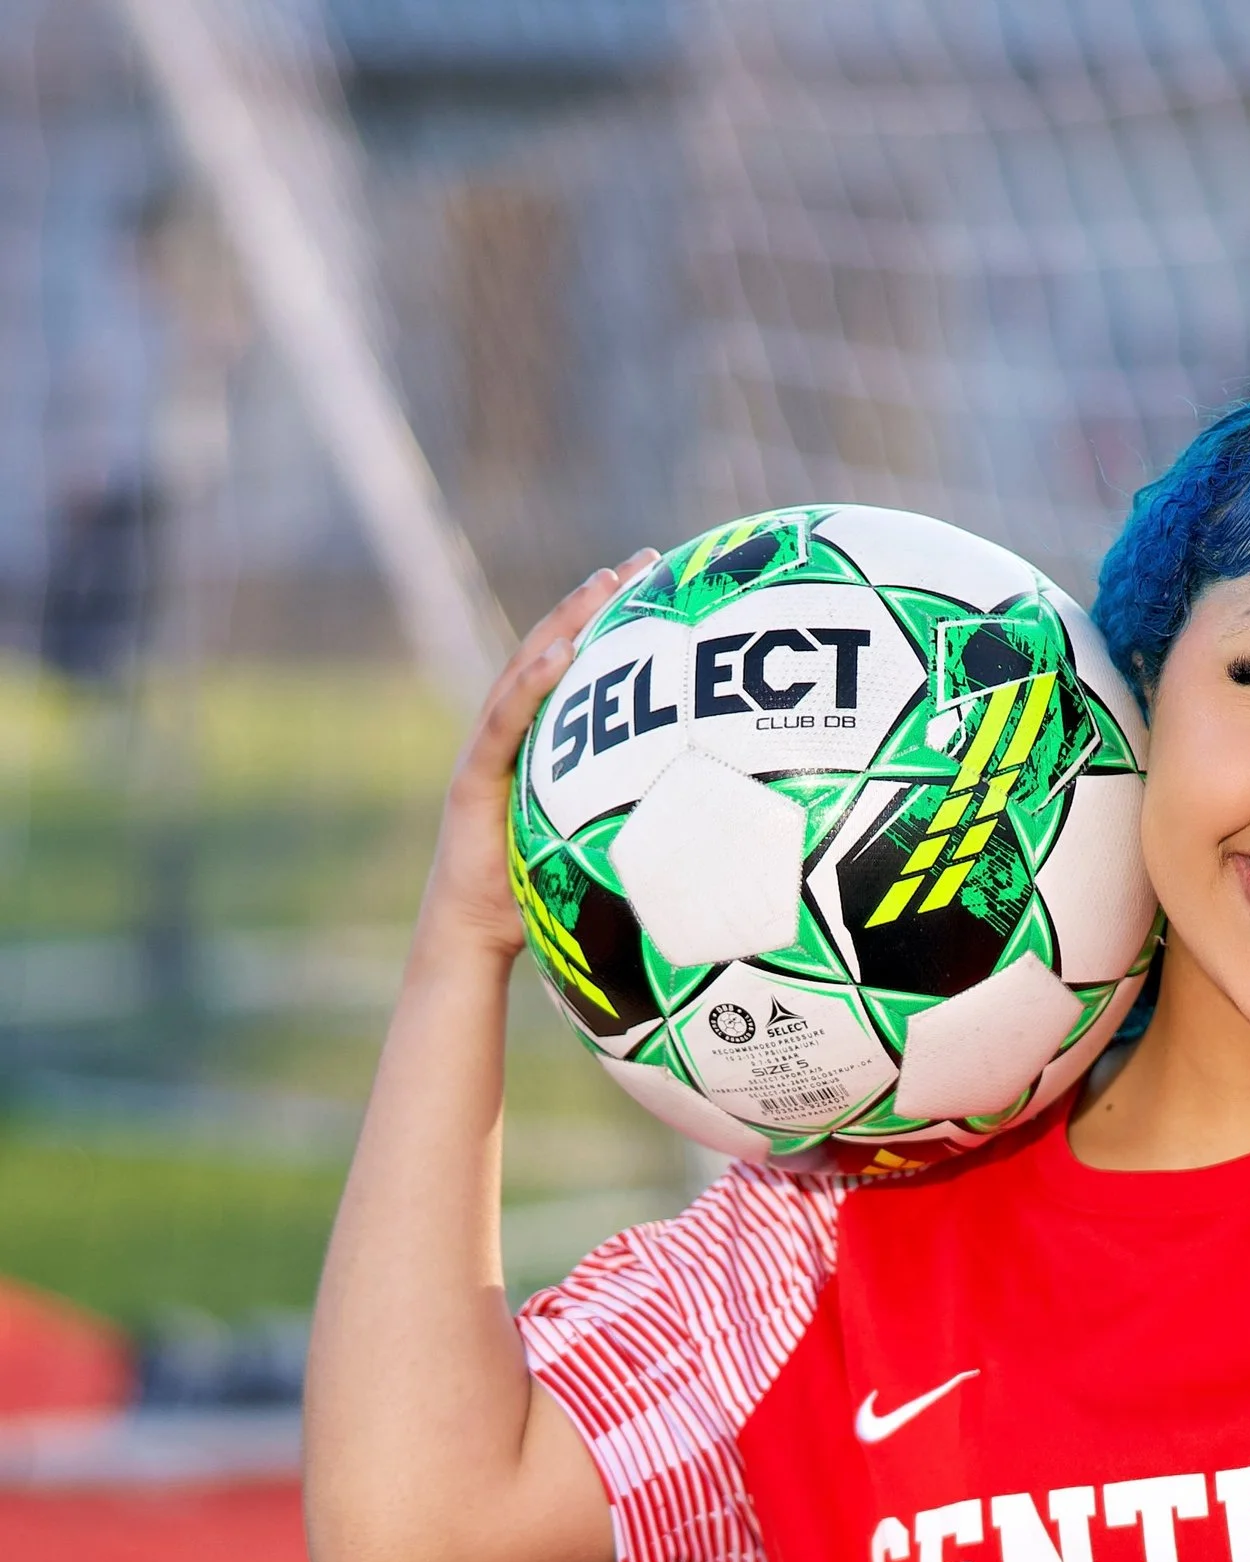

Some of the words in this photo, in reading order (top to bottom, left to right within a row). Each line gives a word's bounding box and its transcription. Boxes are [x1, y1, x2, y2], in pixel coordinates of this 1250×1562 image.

[552, 628, 871, 783] SELECT
[755, 715, 815, 730] CLUB
[823, 715, 856, 728] DB
[767, 1020, 809, 1038] SELECT
[712, 1041, 776, 1055] RECOMMENDED
[778, 1028, 826, 1045] PRESSURE
[781, 1052, 799, 1062] BAR
[751, 1062, 793, 1077] SIZE
[796, 1058, 809, 1069] 5
[748, 1075, 778, 1085] SELECT
[780, 1070, 807, 1080] SPORT
[808, 1104, 850, 1116] PAKISTAN
